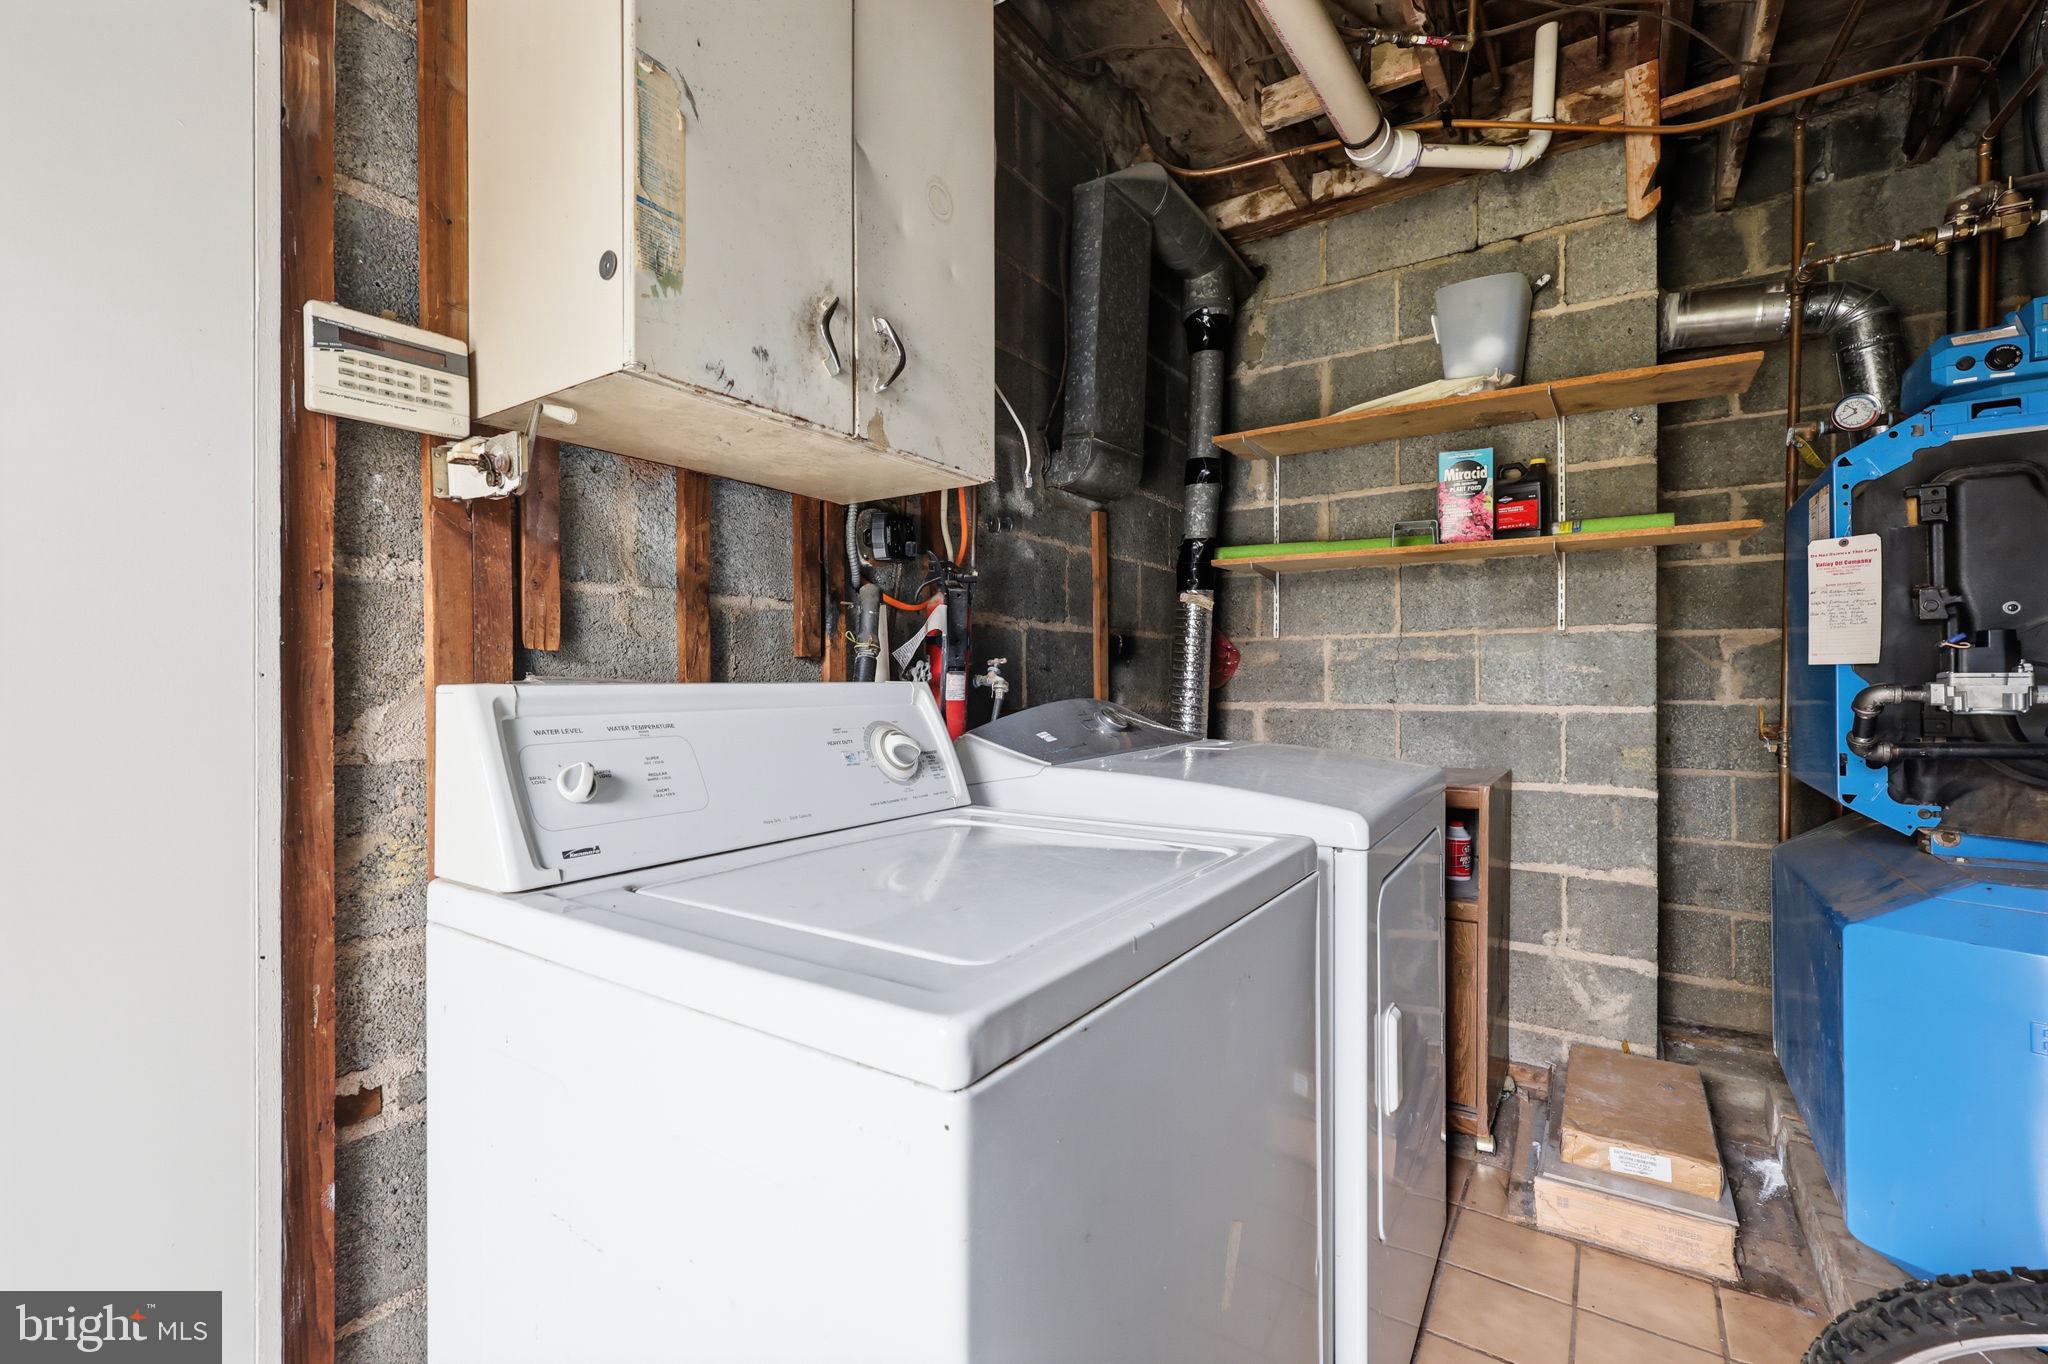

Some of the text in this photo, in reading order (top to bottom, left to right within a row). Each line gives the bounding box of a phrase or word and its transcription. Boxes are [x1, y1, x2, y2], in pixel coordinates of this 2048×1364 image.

[1443, 464, 1488, 482] Miracid
[1449, 485, 1467, 493] PLANT
[631, 723, 675, 731] TEMPERATURE
[533, 727, 584, 736] WATER LEVEL
